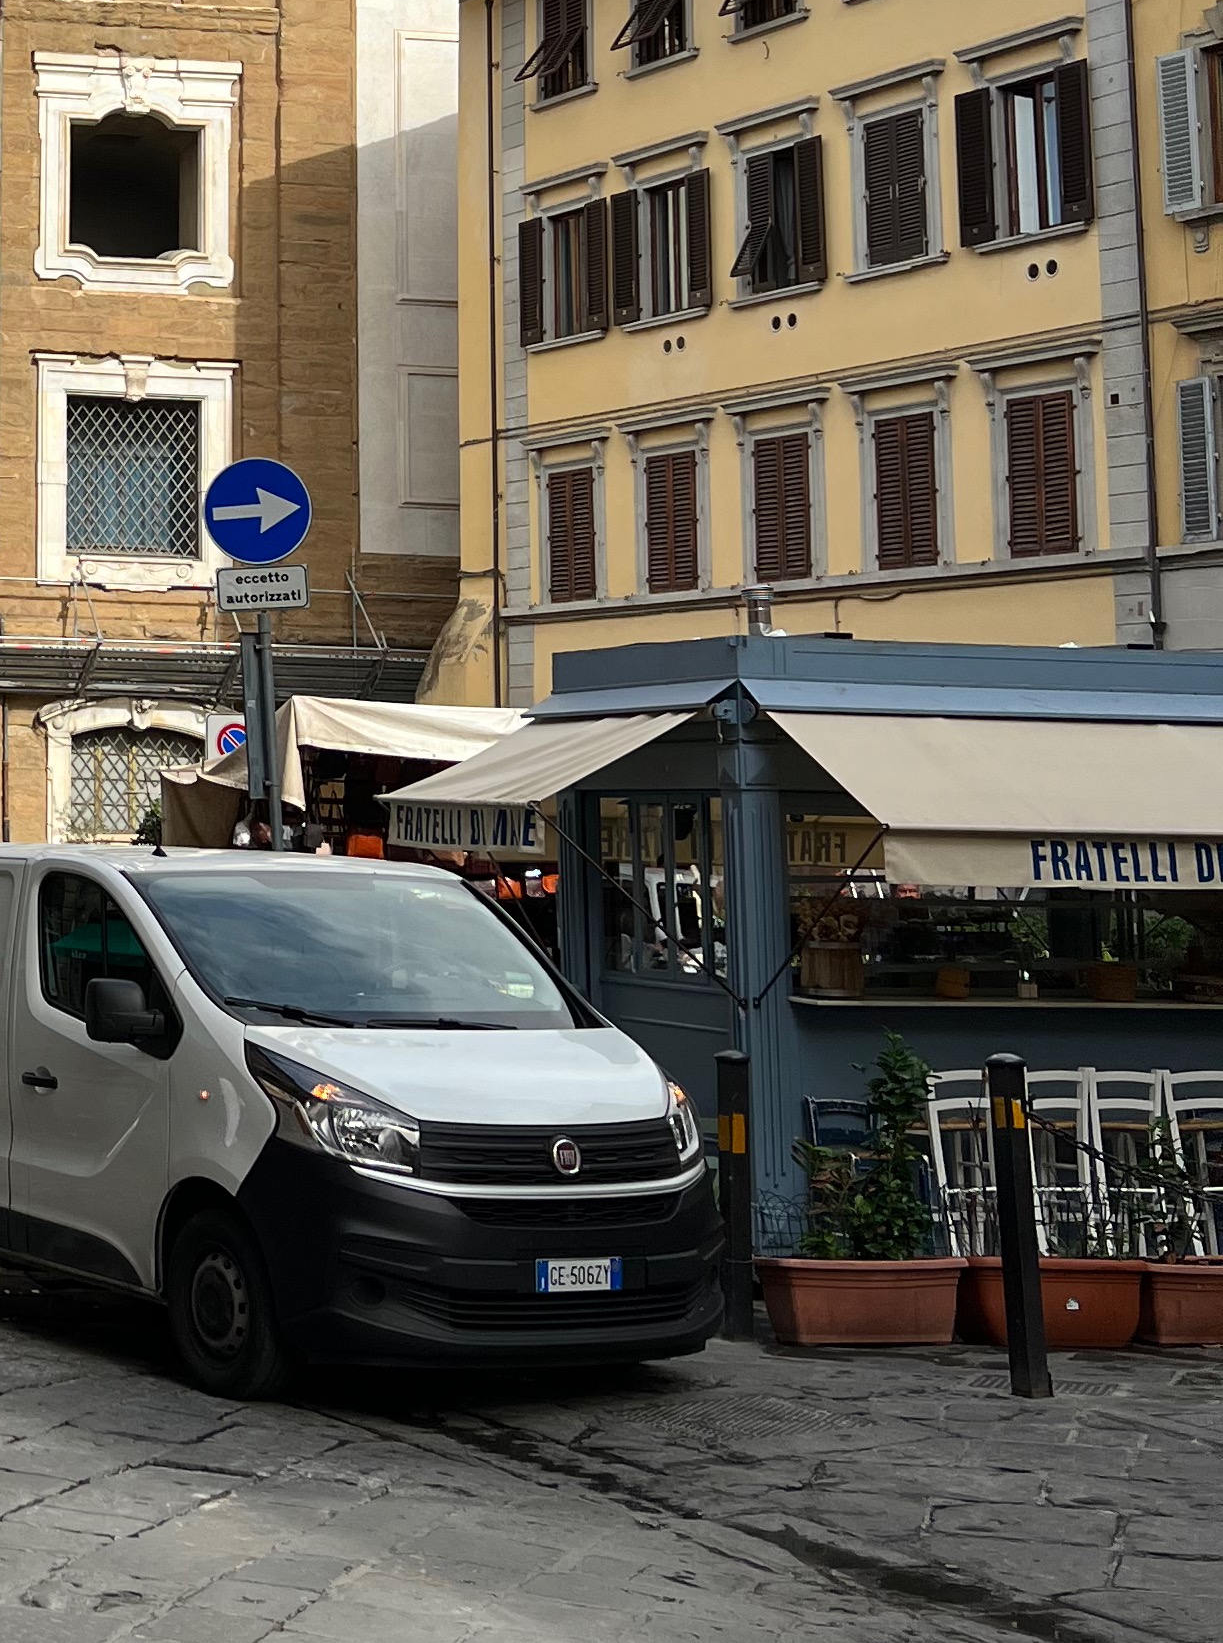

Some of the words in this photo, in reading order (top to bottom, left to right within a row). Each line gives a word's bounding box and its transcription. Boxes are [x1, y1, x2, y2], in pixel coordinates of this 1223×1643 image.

[235, 572, 289, 584] eccetto
[226, 589, 301, 604] autorizzati
[396, 806, 462, 845] FRATELLI
[1030, 840, 1179, 883] FRATELLI
